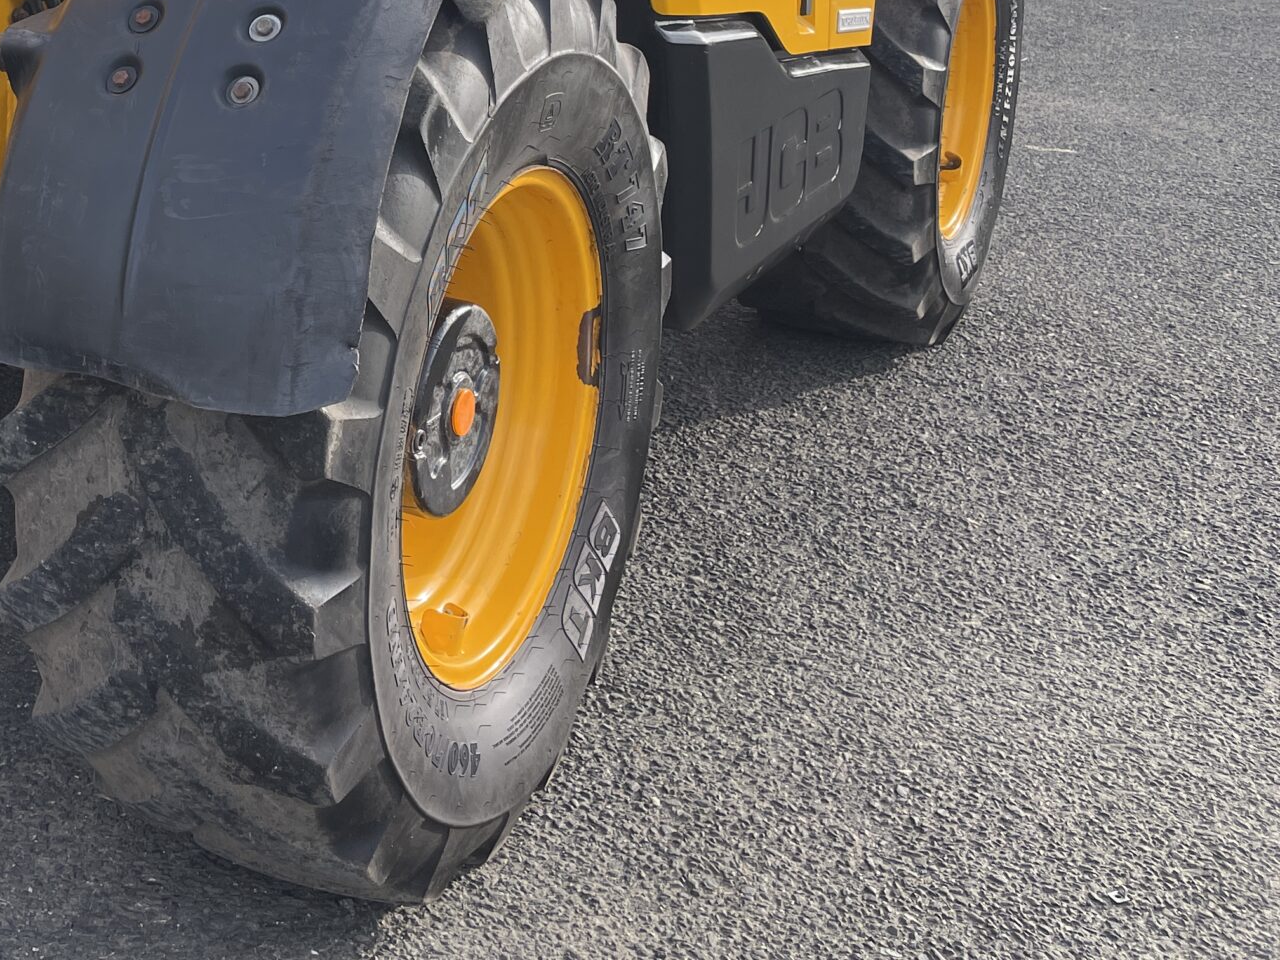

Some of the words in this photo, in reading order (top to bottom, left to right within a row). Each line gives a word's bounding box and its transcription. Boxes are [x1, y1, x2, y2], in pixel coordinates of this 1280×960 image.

[735, 88, 844, 248] JCB
[957, 243, 978, 283] BKT
[568, 508, 619, 651] BKT
